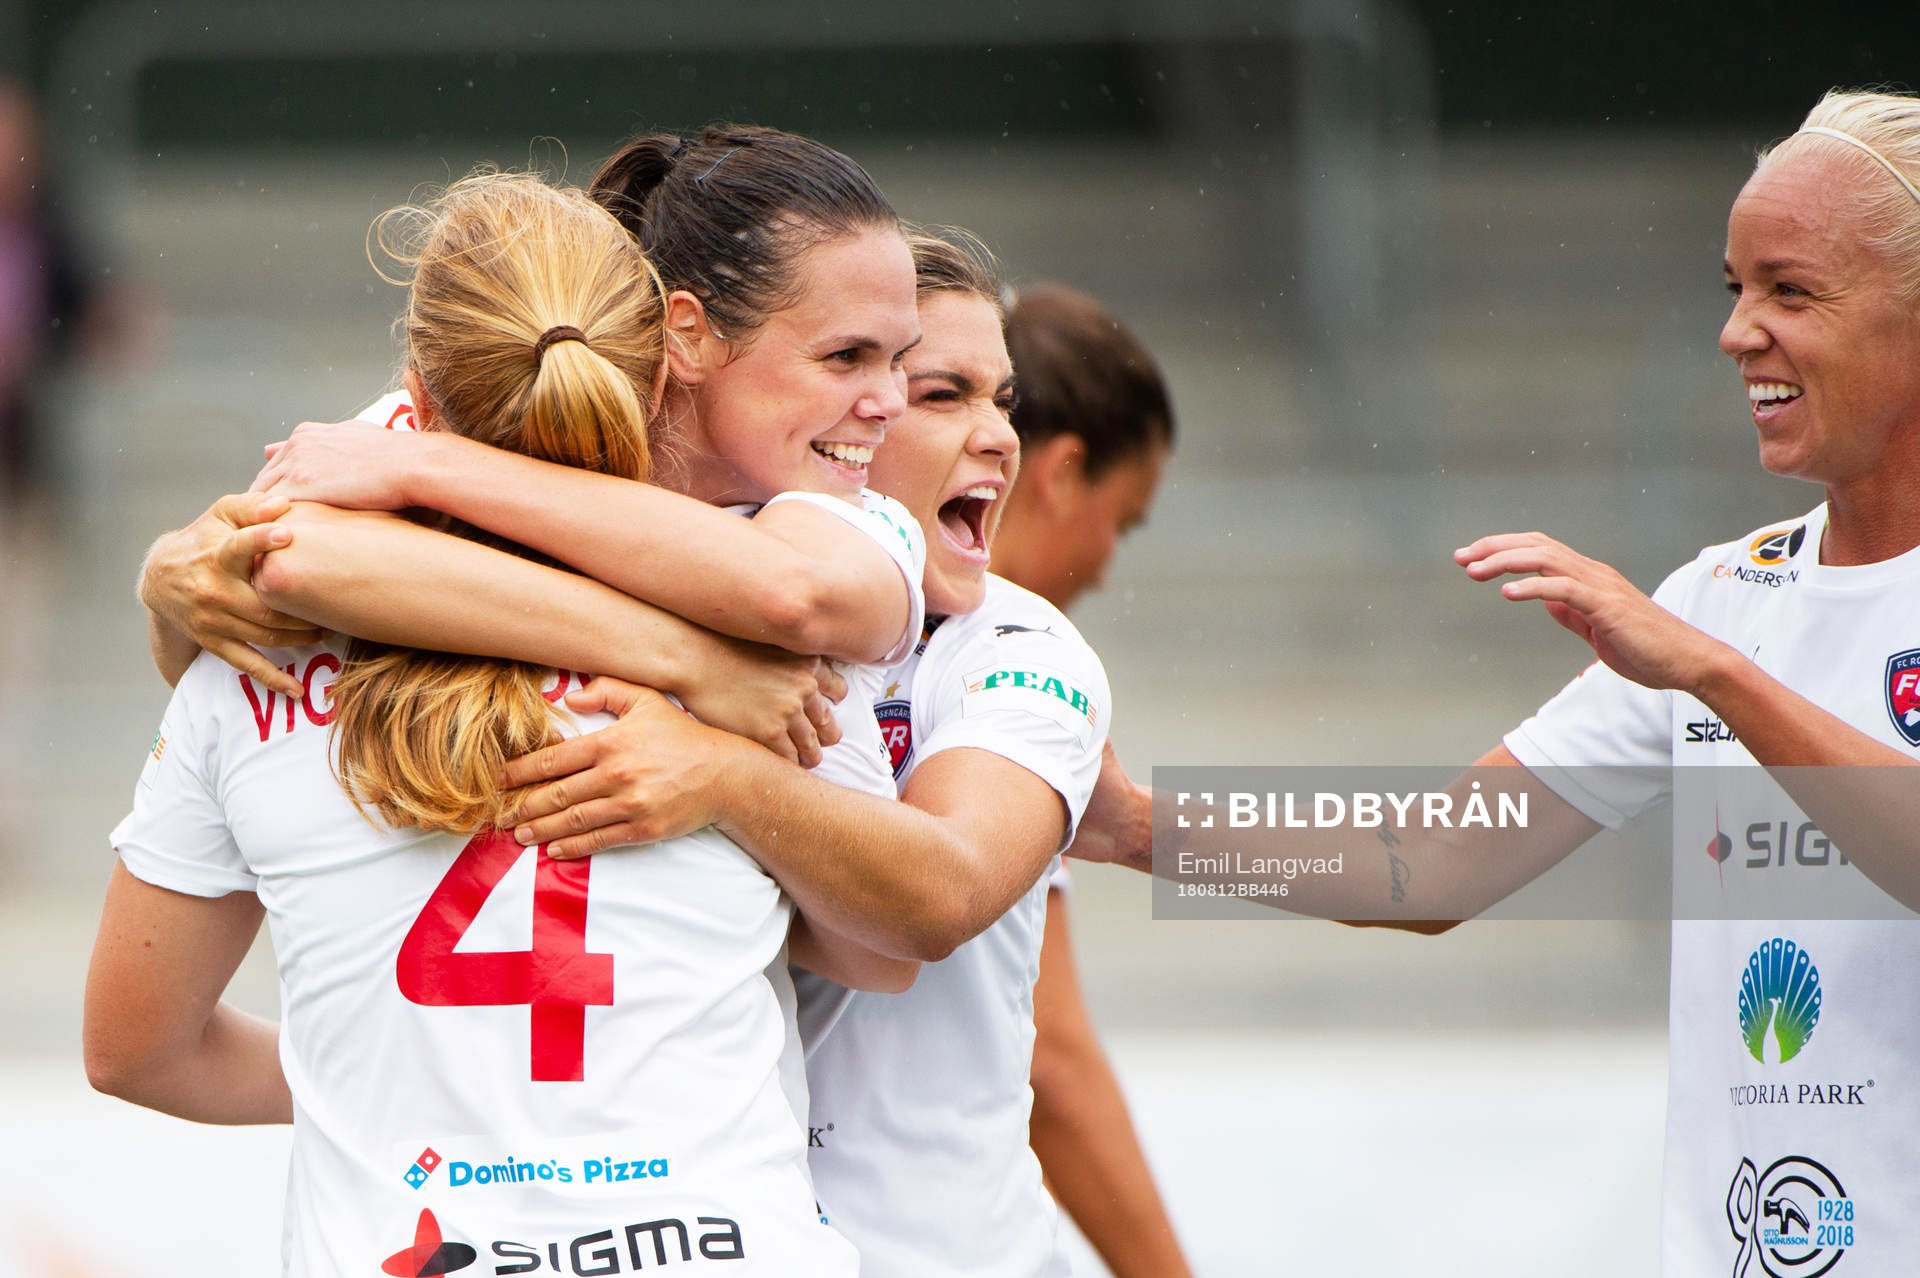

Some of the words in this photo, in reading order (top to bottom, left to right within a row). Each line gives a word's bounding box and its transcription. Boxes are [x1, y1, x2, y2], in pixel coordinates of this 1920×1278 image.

[1746, 821, 1848, 868] SIG
[396, 822, 614, 1081] 4
[449, 1157, 573, 1187] Domino's
[584, 1158, 669, 1183] Pizza
[1817, 1201, 1854, 1221] 1928
[1816, 1226, 1854, 1246] 2018
